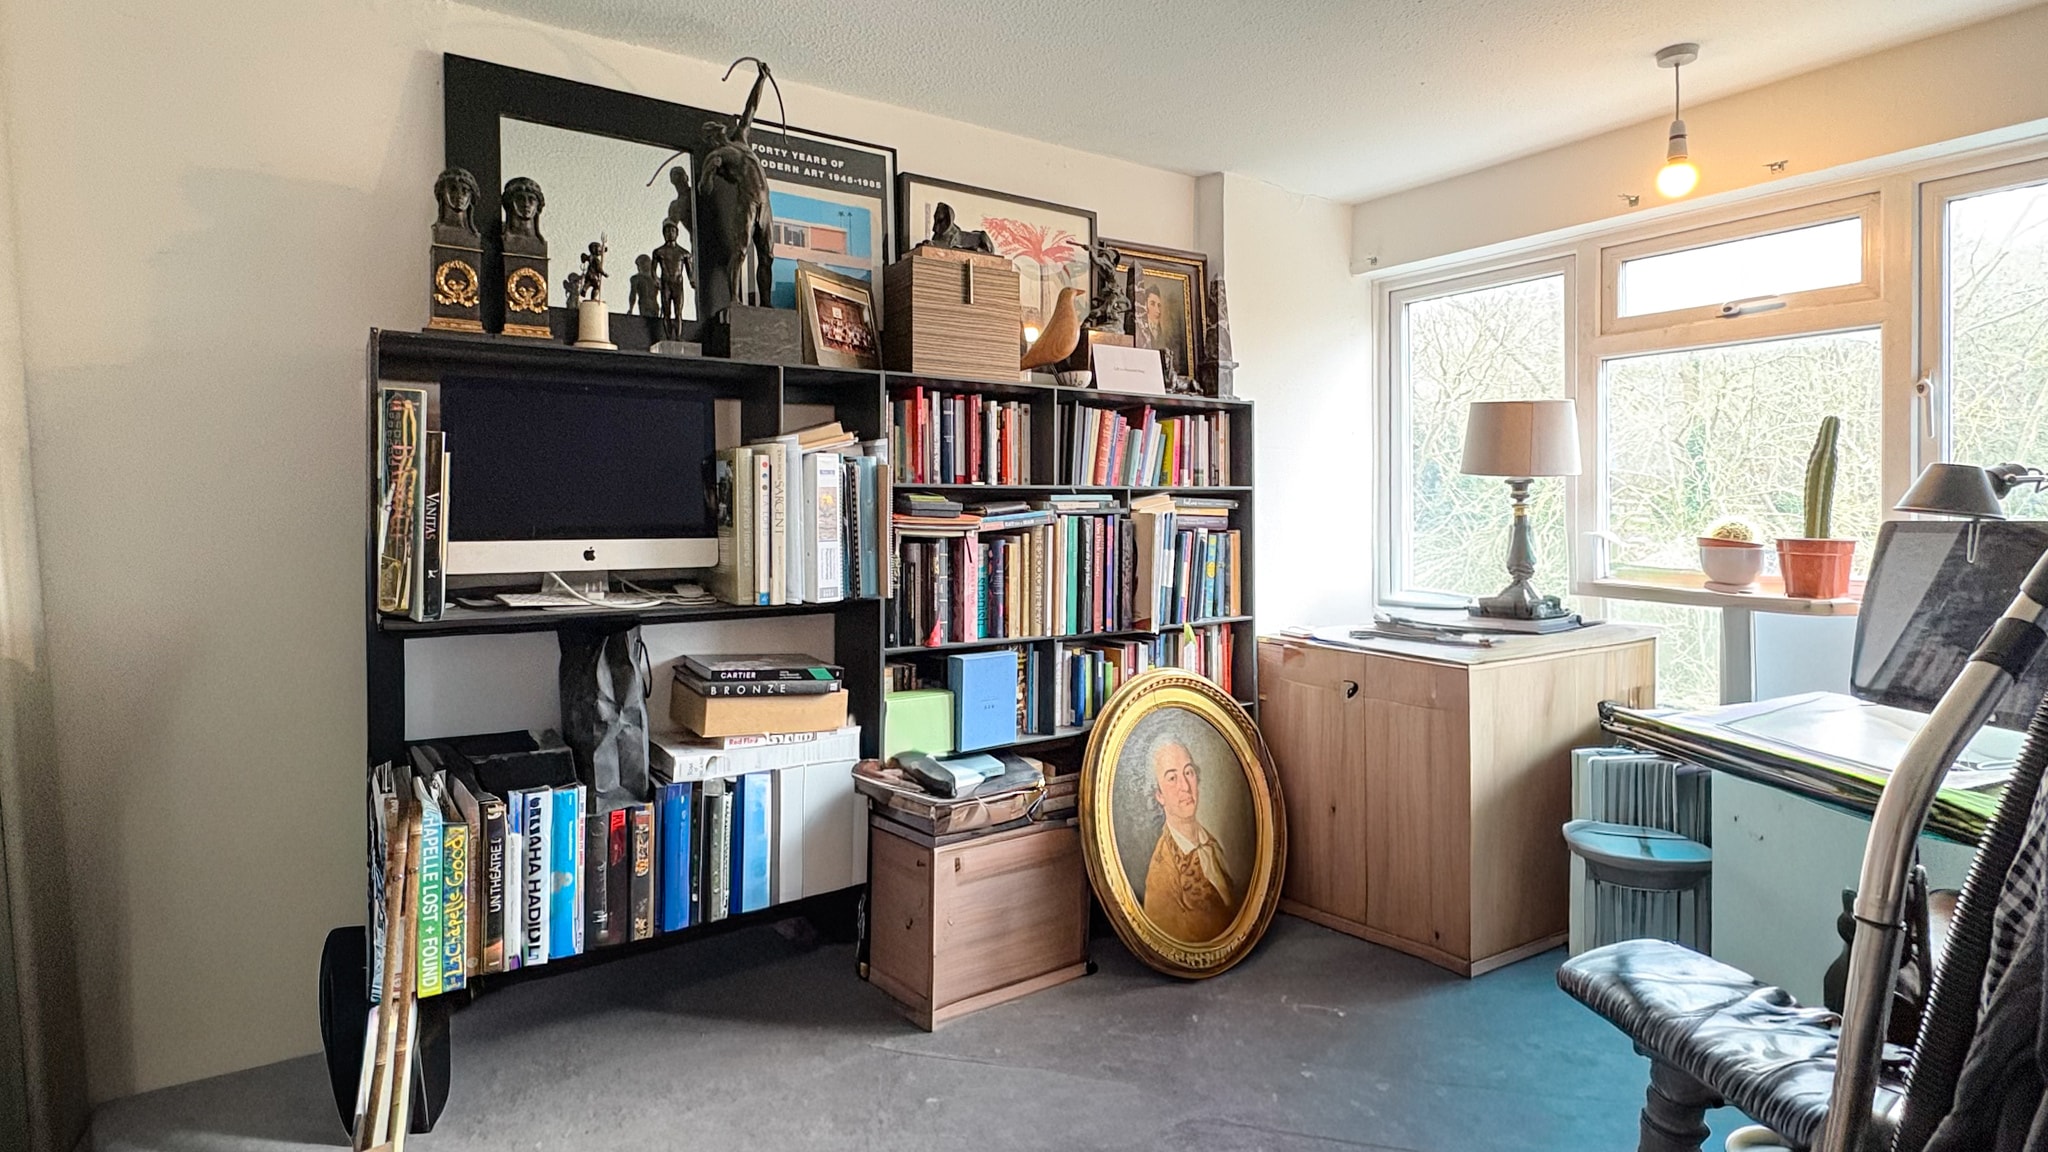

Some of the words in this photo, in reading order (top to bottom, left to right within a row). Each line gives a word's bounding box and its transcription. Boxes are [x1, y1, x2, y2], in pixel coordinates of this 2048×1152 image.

[751, 143, 788, 158] FORTY
[791, 151, 828, 166] YEARS
[830, 159, 845, 169] OF
[760, 159, 800, 174] ODERN
[803, 167, 825, 179] ART
[426, 492, 439, 541] VANITAS
[774, 480, 784, 535] SARGENT
[710, 683, 787, 696] BRONZE
[720, 671, 757, 680] CARTIER
[422, 806, 439, 883] CHAPELLE
[422, 884, 439, 922] LOST
[421, 937, 439, 987] FOUND
